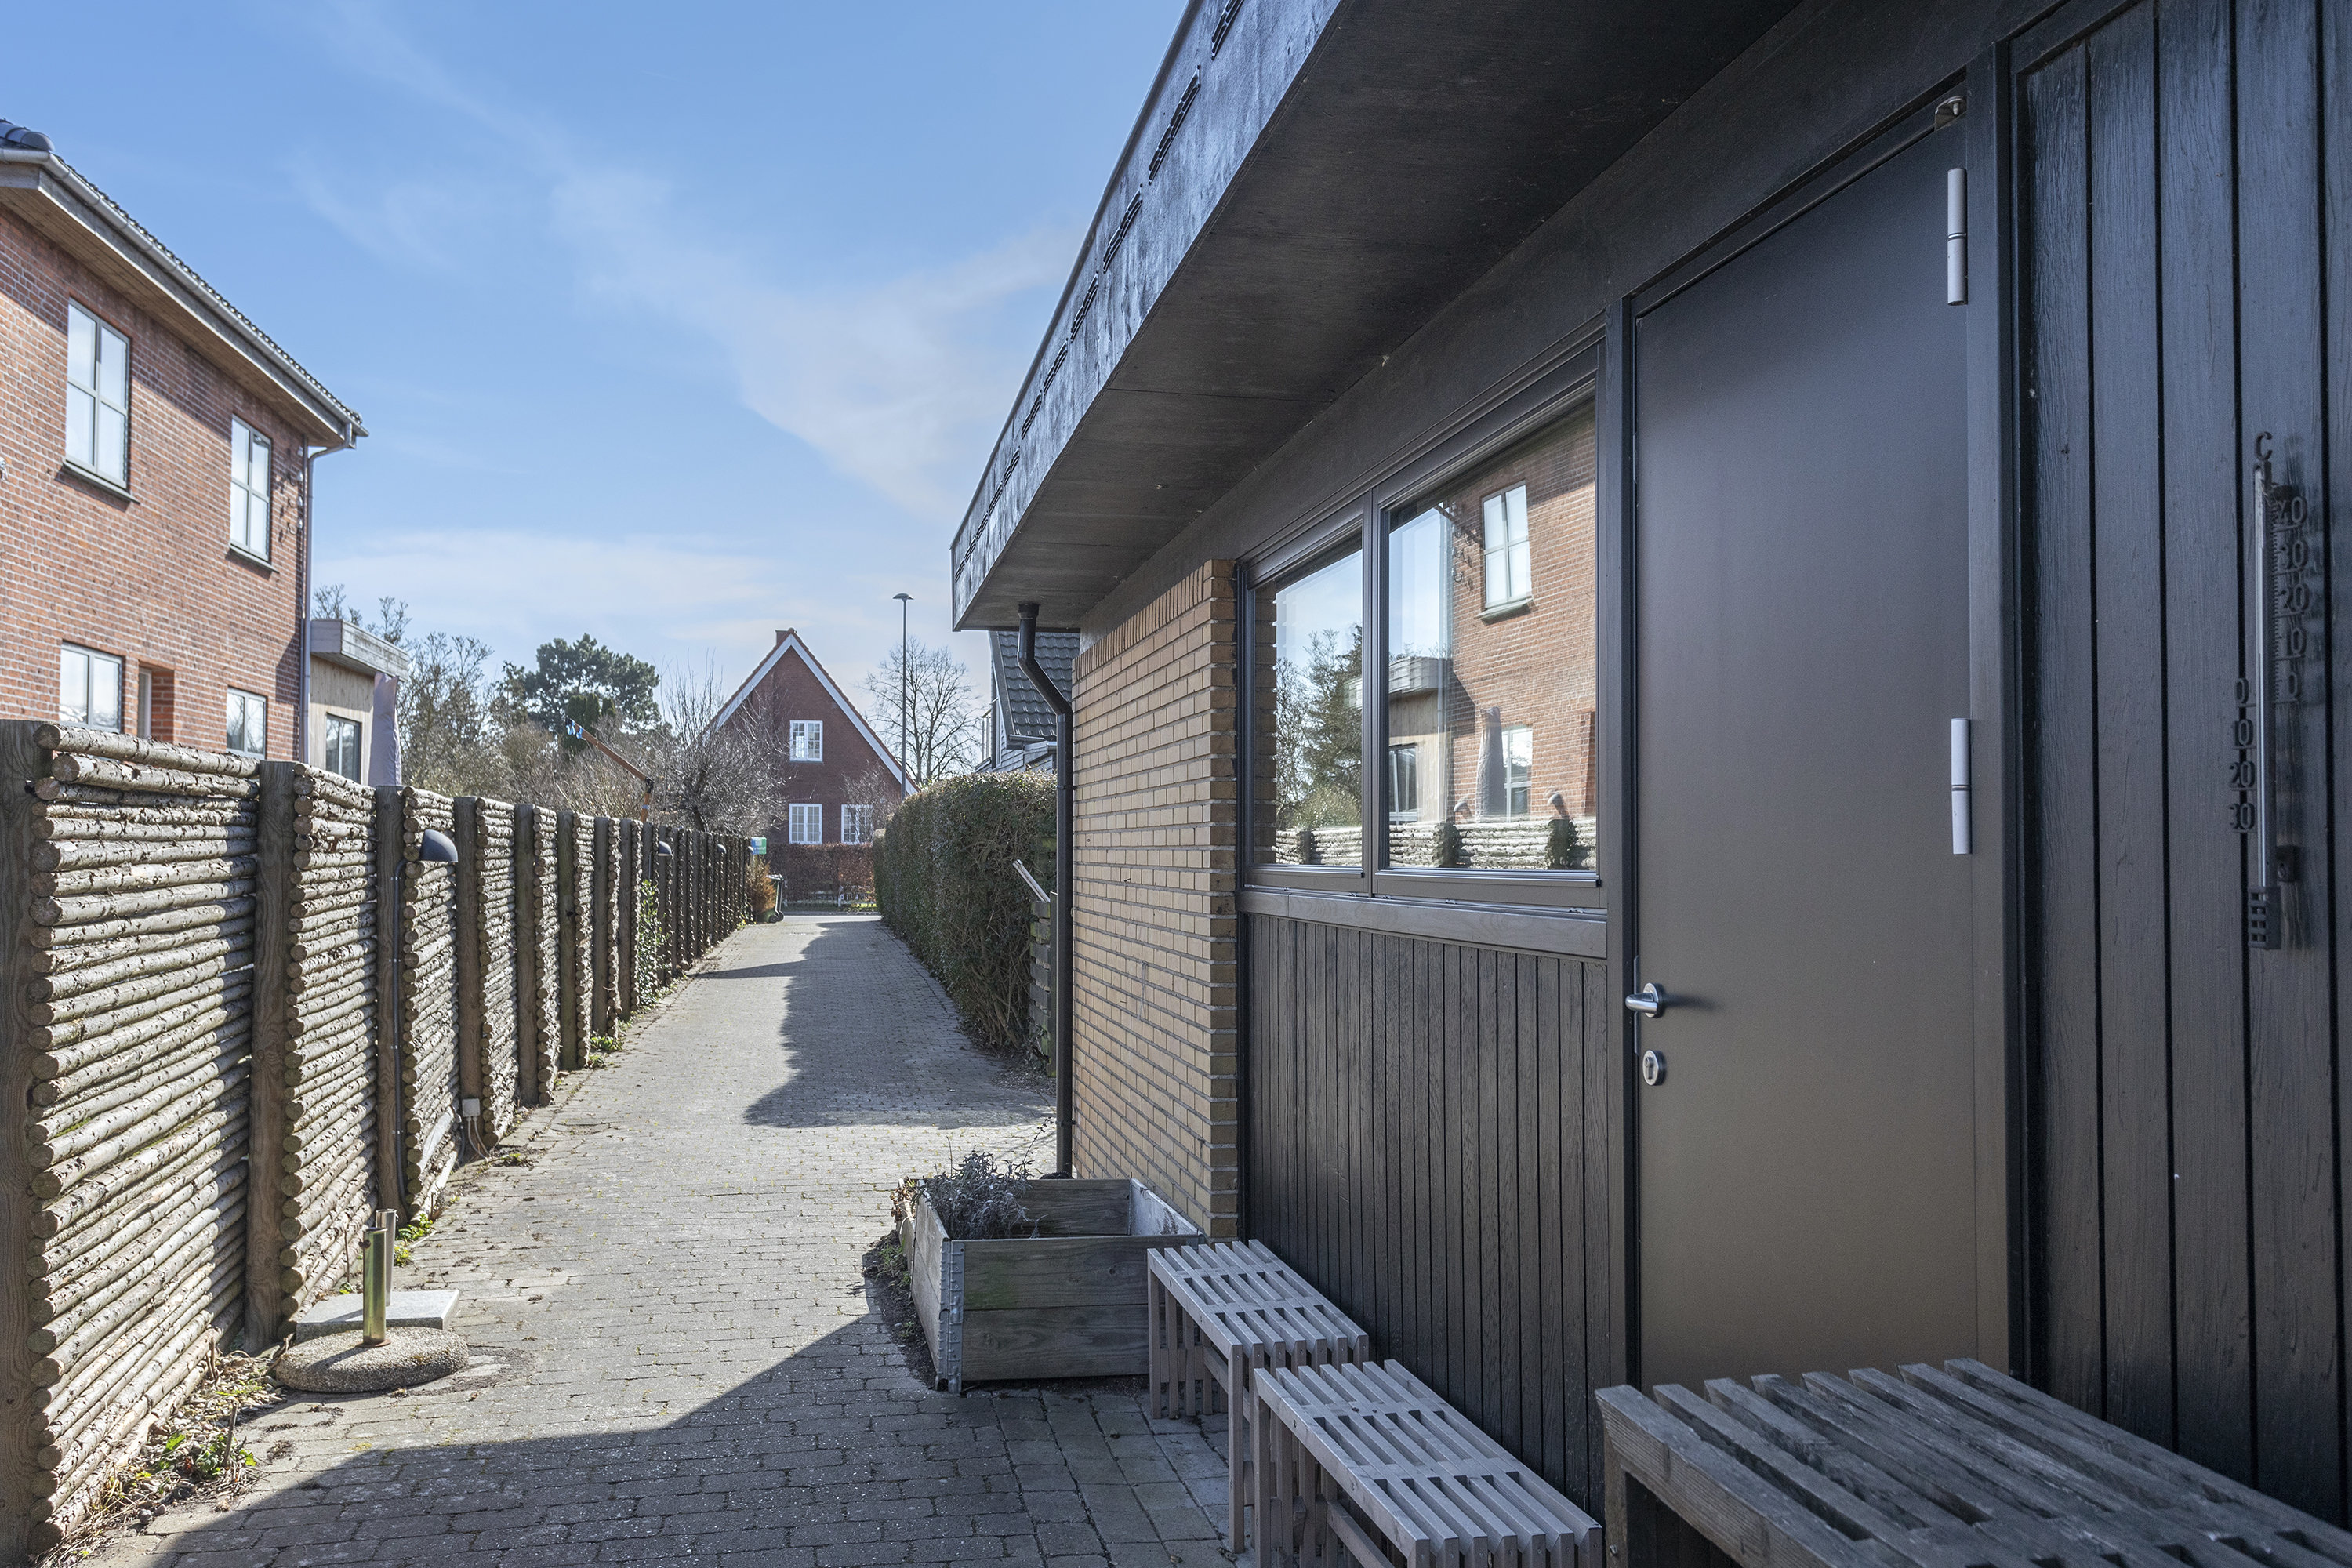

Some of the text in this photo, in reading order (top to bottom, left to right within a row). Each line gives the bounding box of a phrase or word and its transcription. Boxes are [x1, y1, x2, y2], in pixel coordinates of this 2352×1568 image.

[2254, 431, 2273, 461] C
[2279, 540, 2308, 571] 30
[2280, 583, 2310, 613] 20
[2286, 626, 2307, 655] 10
[2234, 677, 2249, 704] 0
[2288, 671, 2302, 699] 0
[2232, 719, 2255, 746] 10
[2229, 760, 2256, 789] 20
